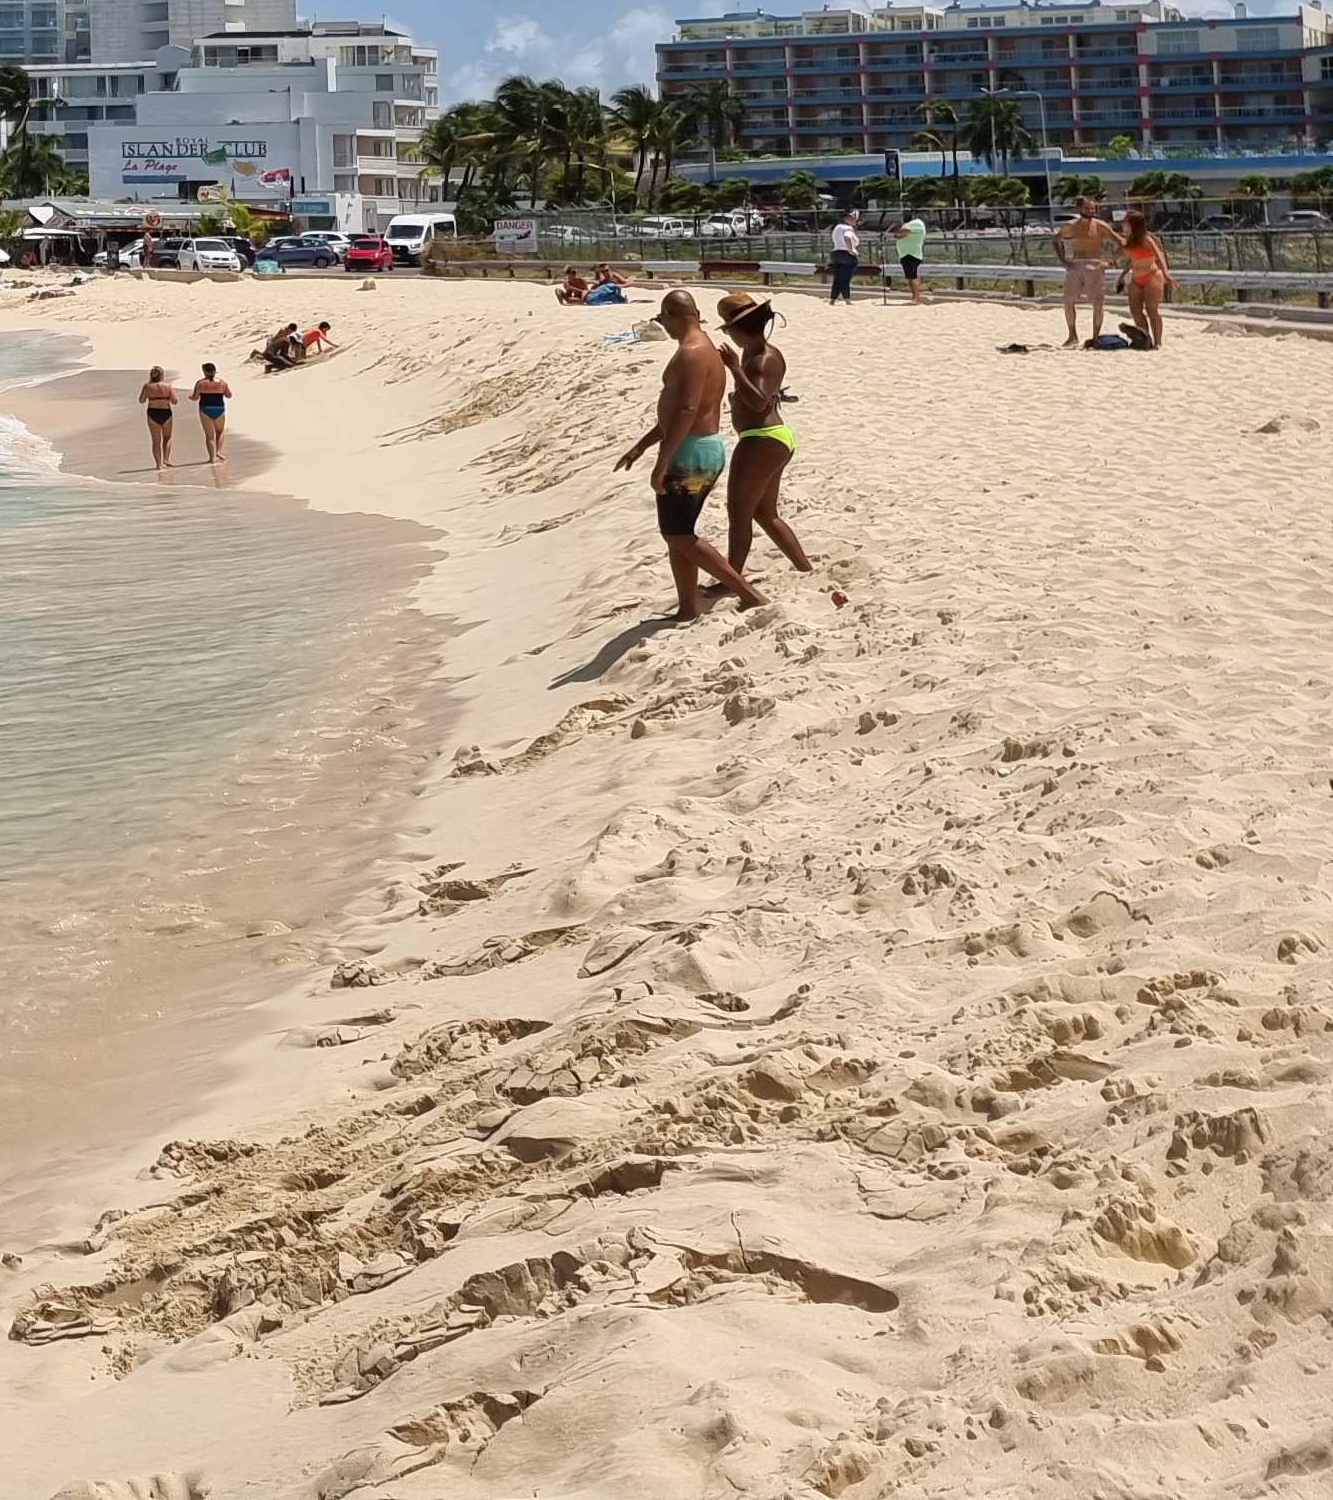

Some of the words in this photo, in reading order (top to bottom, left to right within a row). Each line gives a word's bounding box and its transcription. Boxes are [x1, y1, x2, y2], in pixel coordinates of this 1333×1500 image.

[121, 143, 208, 156] ISLANDER
[221, 142, 267, 155] CLUB
[121, 159, 138, 171] La
[144, 159, 178, 174] Plage
[496, 221, 533, 230] DANGER
